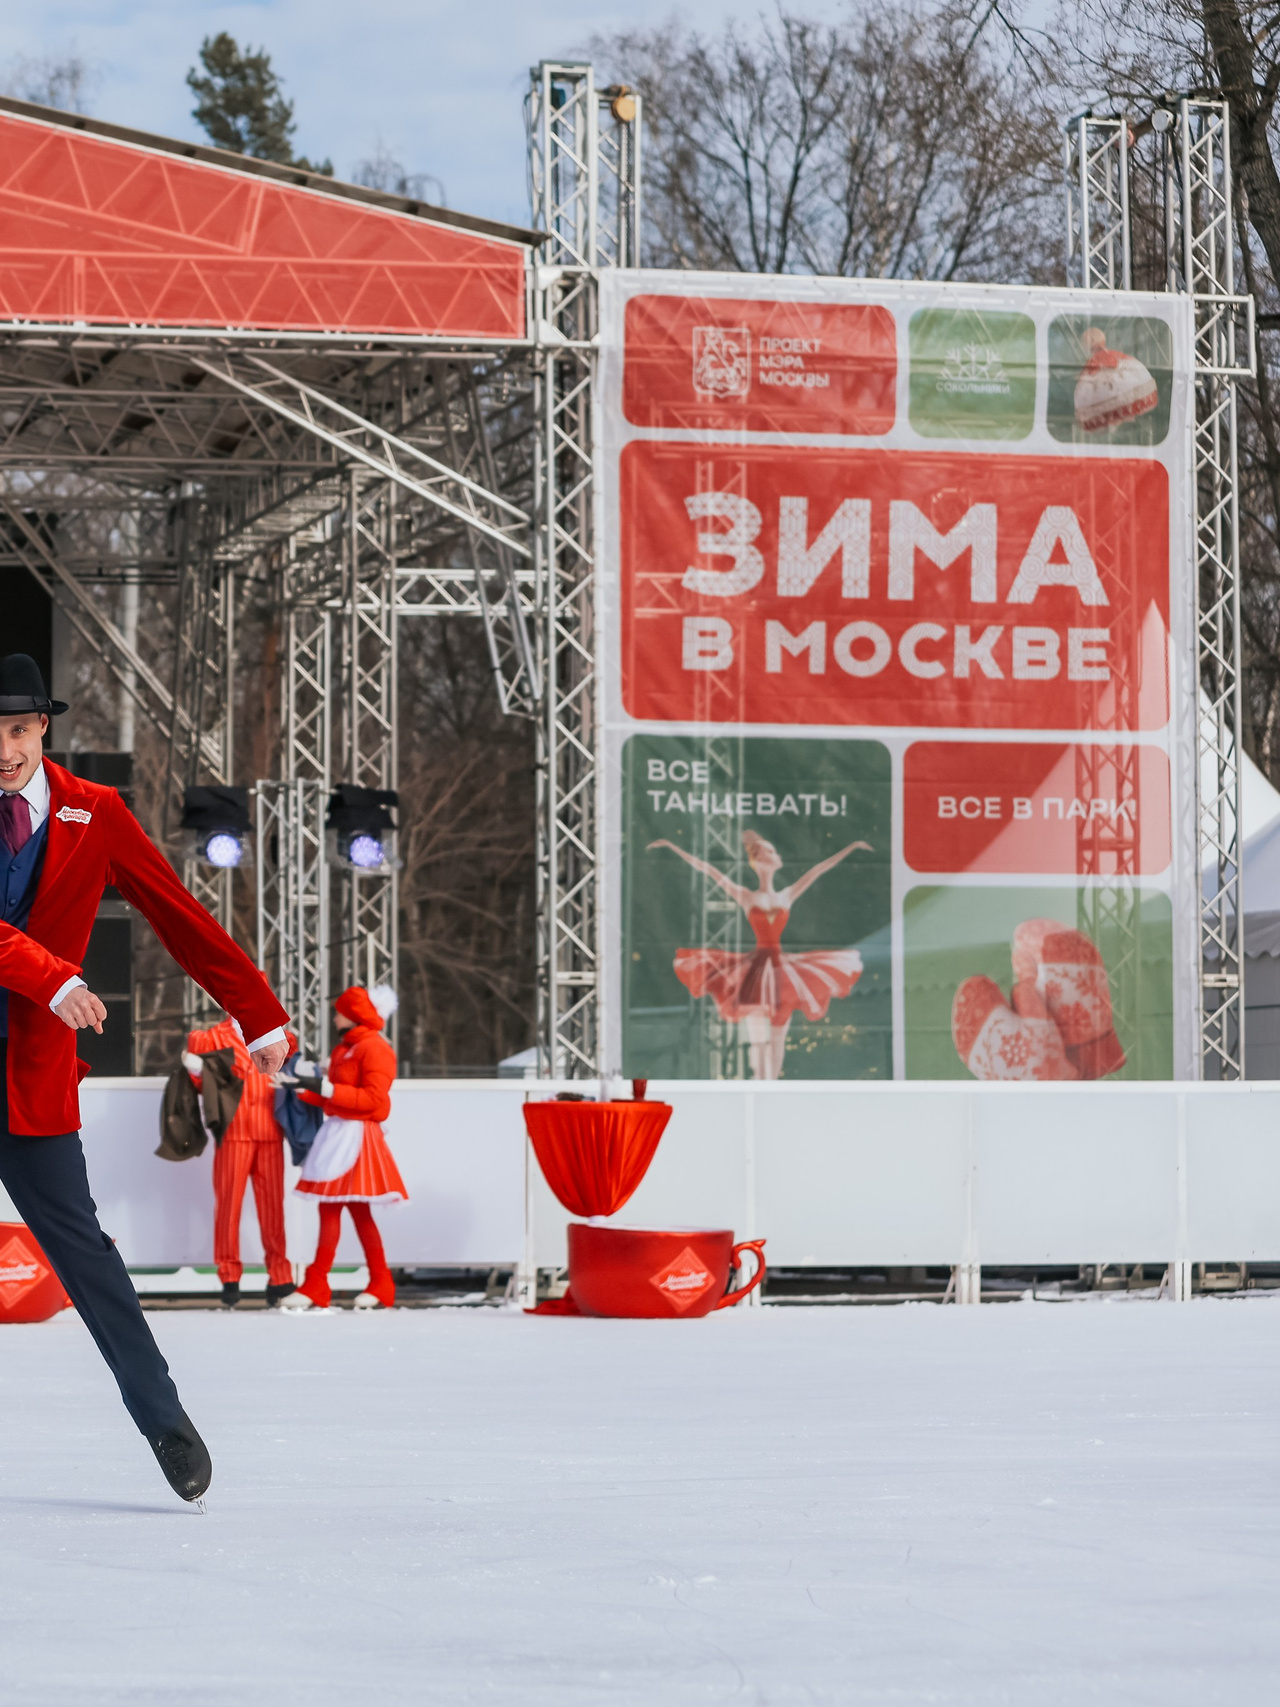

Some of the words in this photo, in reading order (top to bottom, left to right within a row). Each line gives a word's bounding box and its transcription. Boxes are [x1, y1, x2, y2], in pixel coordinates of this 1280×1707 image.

[759, 337, 821, 353] ПРОЕКТ
[759, 355, 805, 369] МЭРА
[759, 371, 831, 388] МОСКВЫ
[935, 381, 1010, 395] СОКОЛЬНИКИ
[681, 492, 1110, 606] ЗИМА
[681, 616, 735, 671] В
[764, 619, 1111, 682] МОСКВЕ
[647, 759, 710, 783] ВСЕ
[647, 790, 847, 818] ТАНЦЕВАТЬ!
[937, 796, 1002, 819] ВСЕ
[1012, 797, 1033, 820] В
[1042, 797, 1137, 821] ПАРК!
